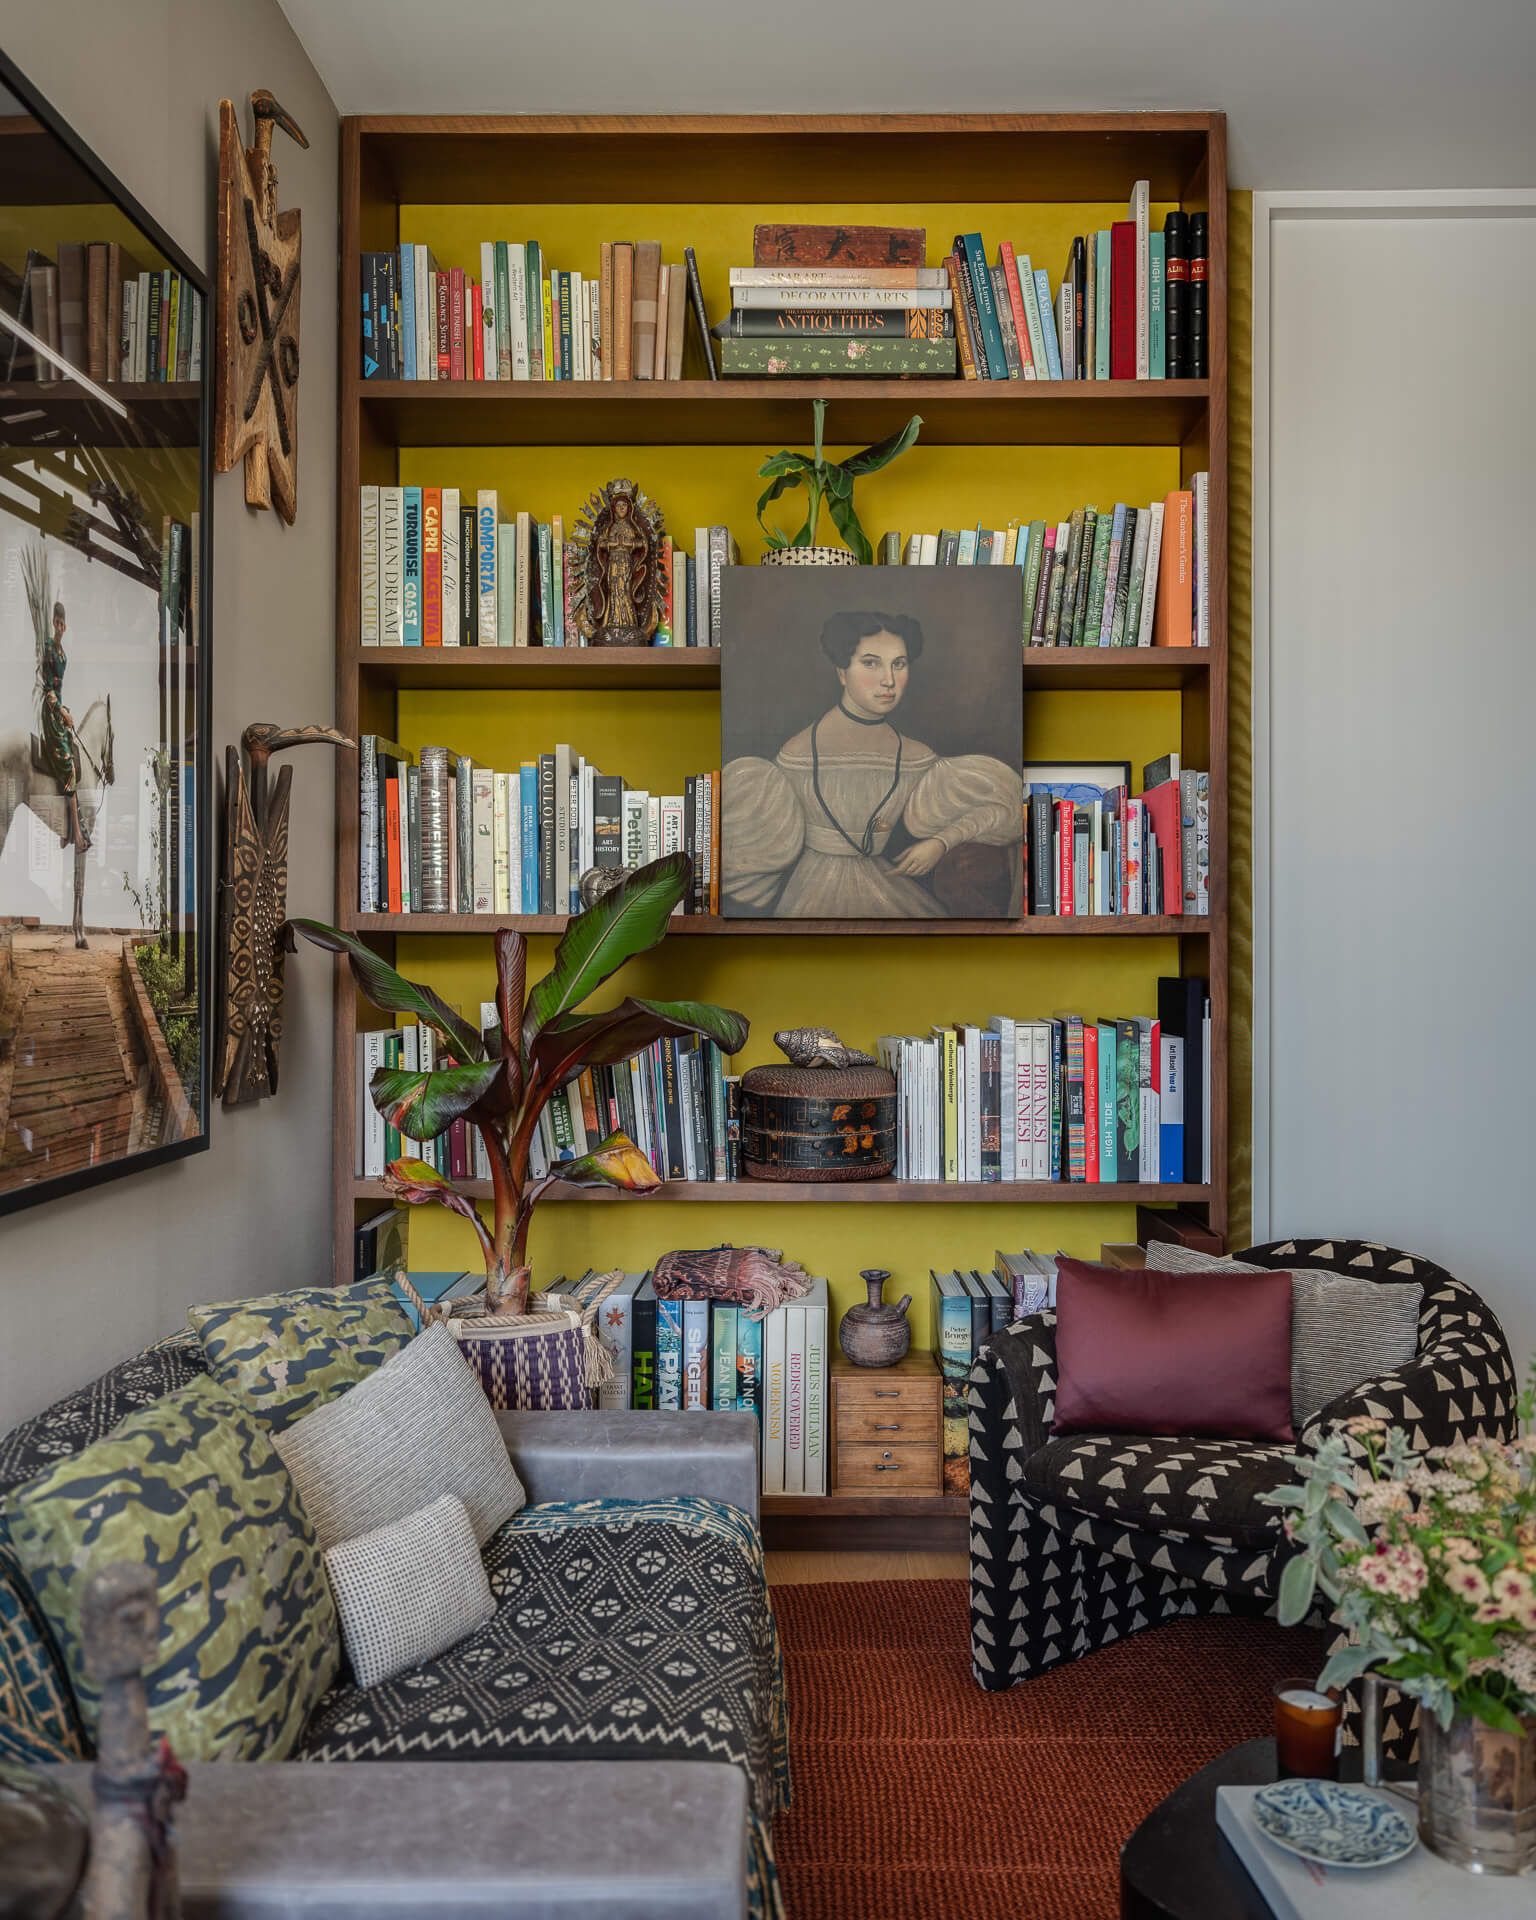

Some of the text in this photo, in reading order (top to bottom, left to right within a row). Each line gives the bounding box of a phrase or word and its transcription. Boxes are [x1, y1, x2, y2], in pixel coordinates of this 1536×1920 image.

[975, 250, 983, 261] SIR
[440, 286, 448, 322] RADIANCE
[780, 290, 909, 303] DECORATIVE ARTS
[1037, 276, 1049, 316] SPLASH
[1152, 257, 1160, 312] HIGH TIDE
[440, 325, 449, 352] SUTRAS
[776, 315, 885, 330] ANTIQUITIES
[479, 507, 494, 594] COMPORTA
[1032, 533, 1040, 566] PARADISE
[1179, 515, 1187, 554] Gardener's
[364, 504, 377, 636] VENETIAN CHIC
[384, 498, 398, 633] ITALIAN DREAM
[405, 504, 418, 626] TURQUOISE COAST
[426, 507, 439, 635] CAPRI DOLCE VITA
[1179, 556, 1187, 583] Garden
[543, 760, 553, 830] LOULOU
[432, 813, 442, 884] WEIWEI
[546, 841, 550, 850] LA
[559, 839, 566, 852] KO
[648, 820, 656, 851] WYETH
[1063, 867, 1071, 897] Investing
[1018, 1064, 1030, 1142] PIRANESI
[1034, 1064, 1047, 1143] PIRANESI
[633, 1352, 653, 1410] HAD
[688, 1328, 701, 1410] SHIGER
[720, 1349, 731, 1383] JEAN
[744, 1349, 755, 1383] JEAN
[769, 1362, 782, 1440] MODERNISM
[790, 1352, 801, 1450] REDISCOVERED
[809, 1345, 820, 1458] JULIUS SHULMAN
